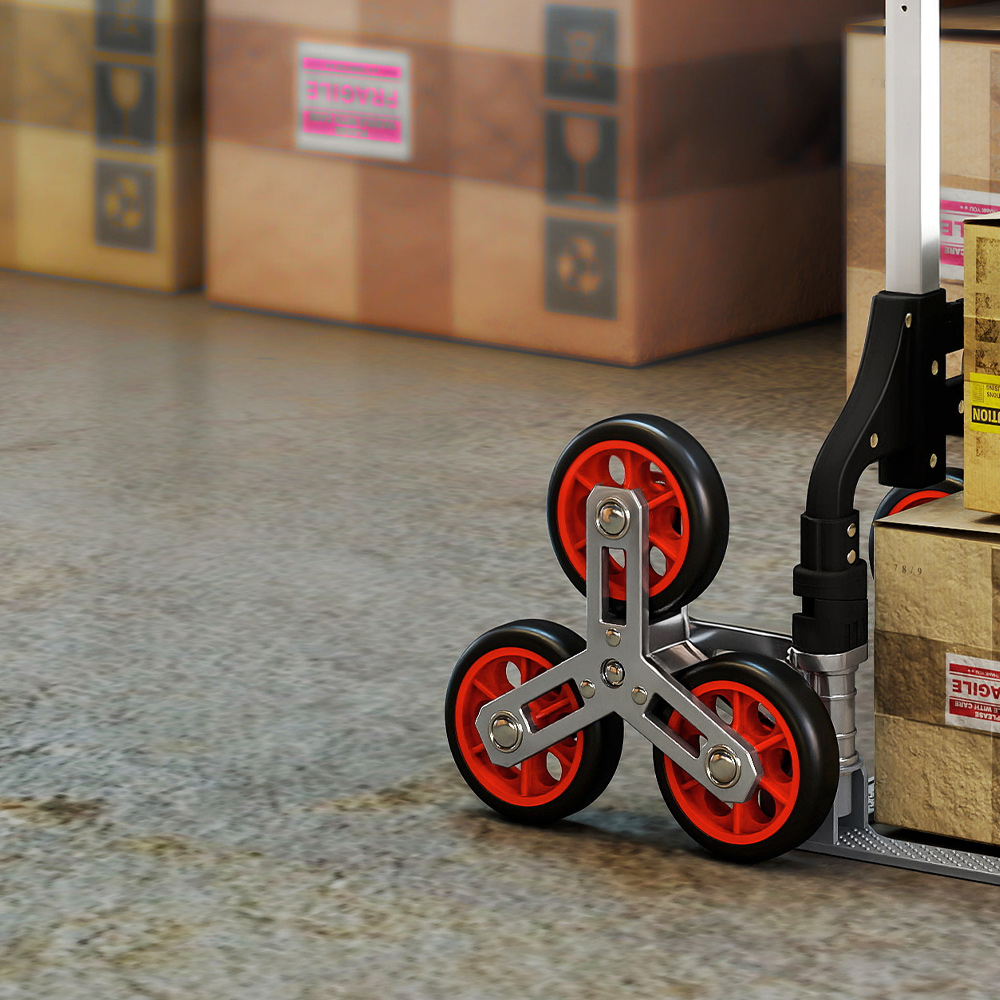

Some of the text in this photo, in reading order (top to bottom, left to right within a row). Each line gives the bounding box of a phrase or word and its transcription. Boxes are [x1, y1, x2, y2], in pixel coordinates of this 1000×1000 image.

[305, 80, 398, 110] FRAGILE
[954, 700, 973, 710] CARE
[974, 704, 992, 712] WITH
[974, 711, 1000, 721] PLEASE
